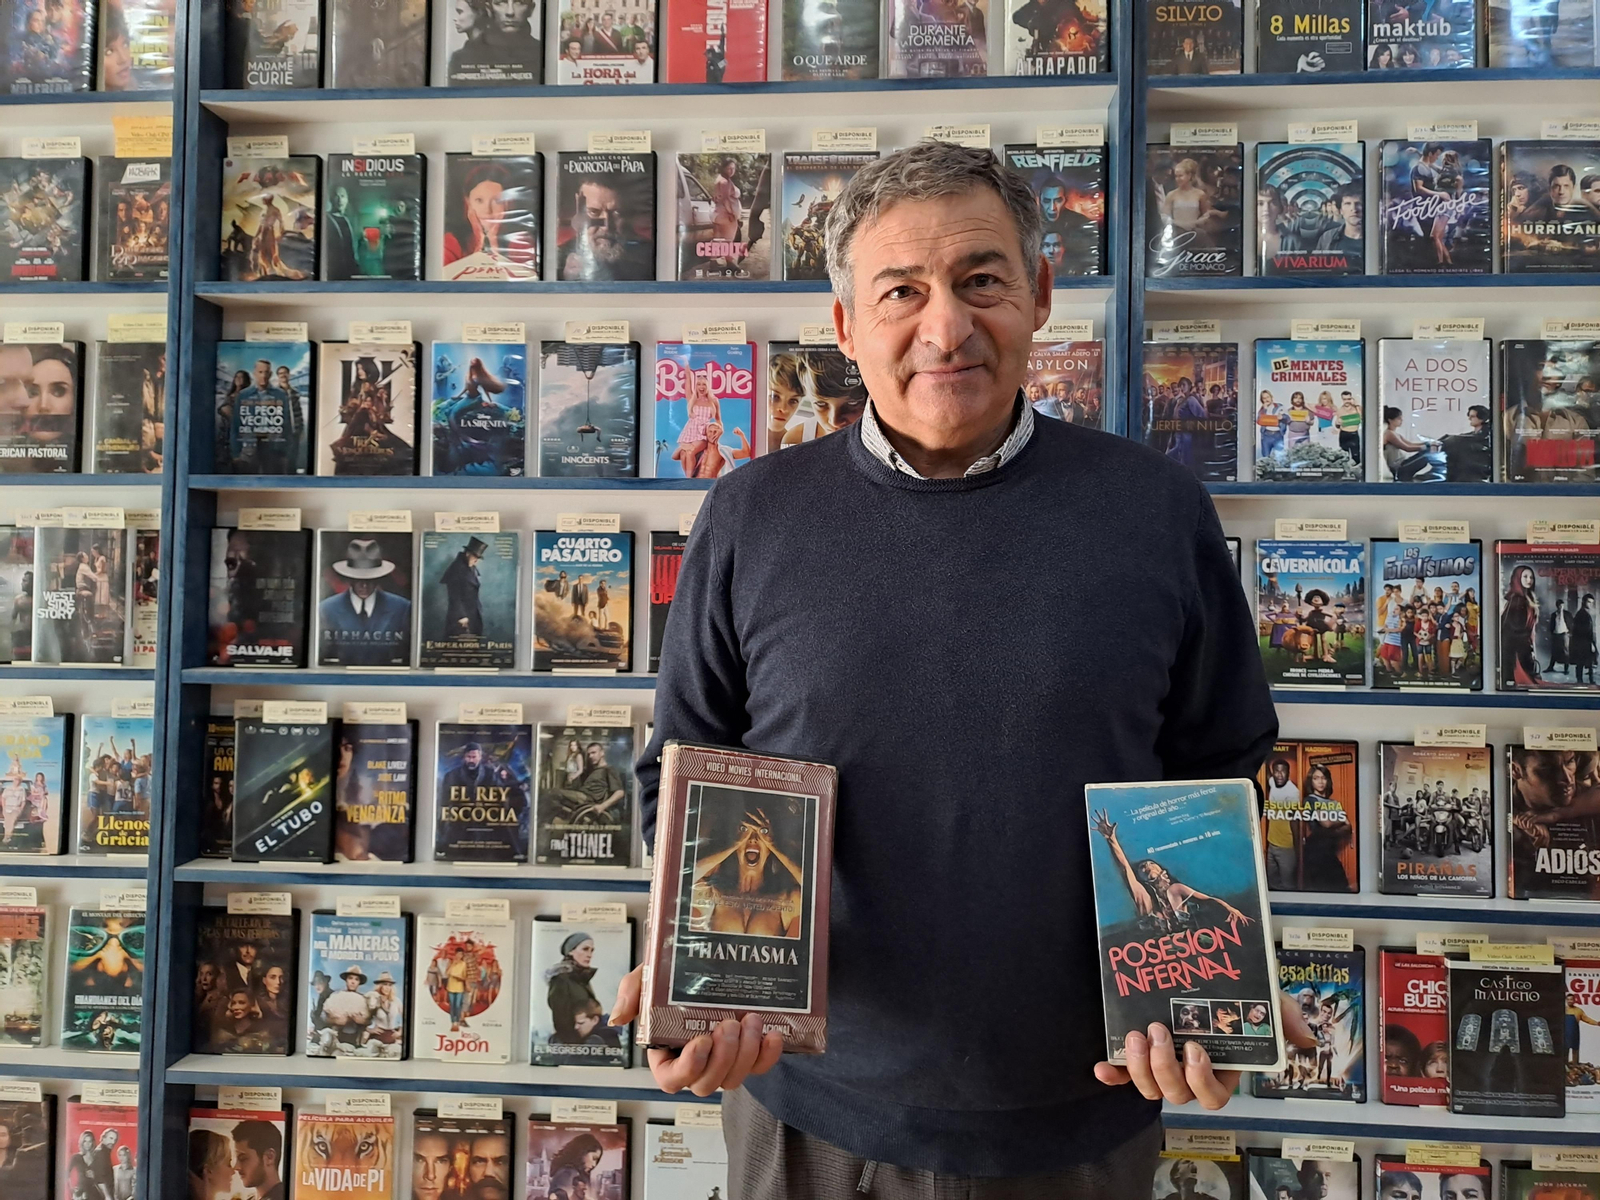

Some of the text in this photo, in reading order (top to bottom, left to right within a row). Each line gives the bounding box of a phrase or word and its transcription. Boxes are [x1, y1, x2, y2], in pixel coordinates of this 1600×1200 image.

[1155, 5, 1223, 22] SILVIO
[910, 24, 967, 36] DURANTE
[1270, 14, 1350, 35] 8 Millas
[1373, 17, 1451, 37] maktub
[908, 35, 976, 47] TORMENTA
[248, 61, 294, 72] MADAME
[793, 54, 868, 67] O QUE ARDE
[1015, 56, 1097, 75] ATRAPADO
[247, 72, 294, 85] CURIE
[583, 68, 622, 79] HORA
[341, 158, 405, 172] INSIDIOUS
[568, 159, 645, 173] EXORCISTA PAPA
[1011, 153, 1098, 172] RENFIELD
[1388, 192, 1489, 229] Footloose
[1149, 231, 1227, 277] Grace
[1179, 263, 1226, 271] DE MONACO
[1272, 256, 1348, 269] VIVARIUM
[1442, 323, 1479, 331] DISPONIBLE
[1273, 358, 1344, 371] DE MENTES
[1404, 358, 1468, 372] A DOS
[655, 360, 752, 397] Barbie
[1271, 371, 1347, 382] CRIMINALES
[1395, 377, 1478, 393] METROS
[239, 405, 283, 416] EL PEOR
[1411, 396, 1461, 412] DE TI
[241, 415, 283, 426] VECINO
[460, 418, 507, 432] LA SIRENITA
[1196, 420, 1234, 431] NILO
[239, 426, 283, 434] DEL MUNDO
[27, 447, 68, 459] PASTORAL
[561, 456, 610, 464] INNOCENTS
[540, 549, 624, 564] PASAJERO
[1403, 546, 1420, 562] LOS
[1261, 555, 1361, 574] CAVERNÍCOLA
[1382, 555, 1475, 582] FUTBOLÍSIMOS
[43, 591, 76, 602] WEST
[47, 600, 76, 610] SIDE
[37, 608, 76, 620] STORY
[323, 630, 404, 641] RIPHAGEN
[225, 645, 294, 657] SALVAJE
[1443, 728, 1481, 736] DISPONIBLE
[706, 761, 804, 783] VIDEO MOVIES INTERNACIONAL
[450, 785, 511, 801] EL REY
[1138, 786, 1217, 815] película de horror más feroz
[1264, 801, 1344, 811] ESCUELA PARA
[346, 804, 406, 824] VENGANZA
[441, 806, 520, 822] ESCOCIA
[1157, 808, 1168, 817] del
[1264, 809, 1347, 822] FRACASADOS
[96, 815, 151, 831] Llenos
[255, 800, 323, 853] EL TUBO
[95, 831, 150, 847] Gracia
[569, 830, 614, 858] TÚNEL
[1146, 847, 1155, 855] NO
[1204, 830, 1211, 839] 18
[1535, 843, 1600, 876] ADIÓS
[1397, 860, 1478, 876] PIRAÑAS
[329, 934, 400, 952] MANERAS
[1311, 932, 1348, 941] DISPONIBLE
[687, 940, 799, 966] PHANTASMA
[1108, 926, 1243, 972] POSESION
[1309, 952, 1349, 960] BLACK
[1114, 951, 1243, 998] INFERNAL
[1407, 979, 1447, 995] CHIC
[1479, 975, 1533, 990] CASTIGO
[74, 994, 130, 1006] GUARDIANES DEL
[1403, 994, 1448, 1008] BUEN
[1474, 989, 1540, 1004] MALIGNO
[685, 1019, 706, 1032] VIDEO
[533, 1046, 624, 1056] EL REGRESO DE BEN
[1411, 1084, 1437, 1098] película
[300, 1114, 334, 1122] PELÍCULA
[662, 1130, 684, 1138] Robert
[660, 1147, 694, 1158] Jeremiah
[1311, 1144, 1349, 1152] DISPONIBLE
[652, 1155, 685, 1164] Johnson
[302, 1167, 385, 1192] LA VIDA DE PI
